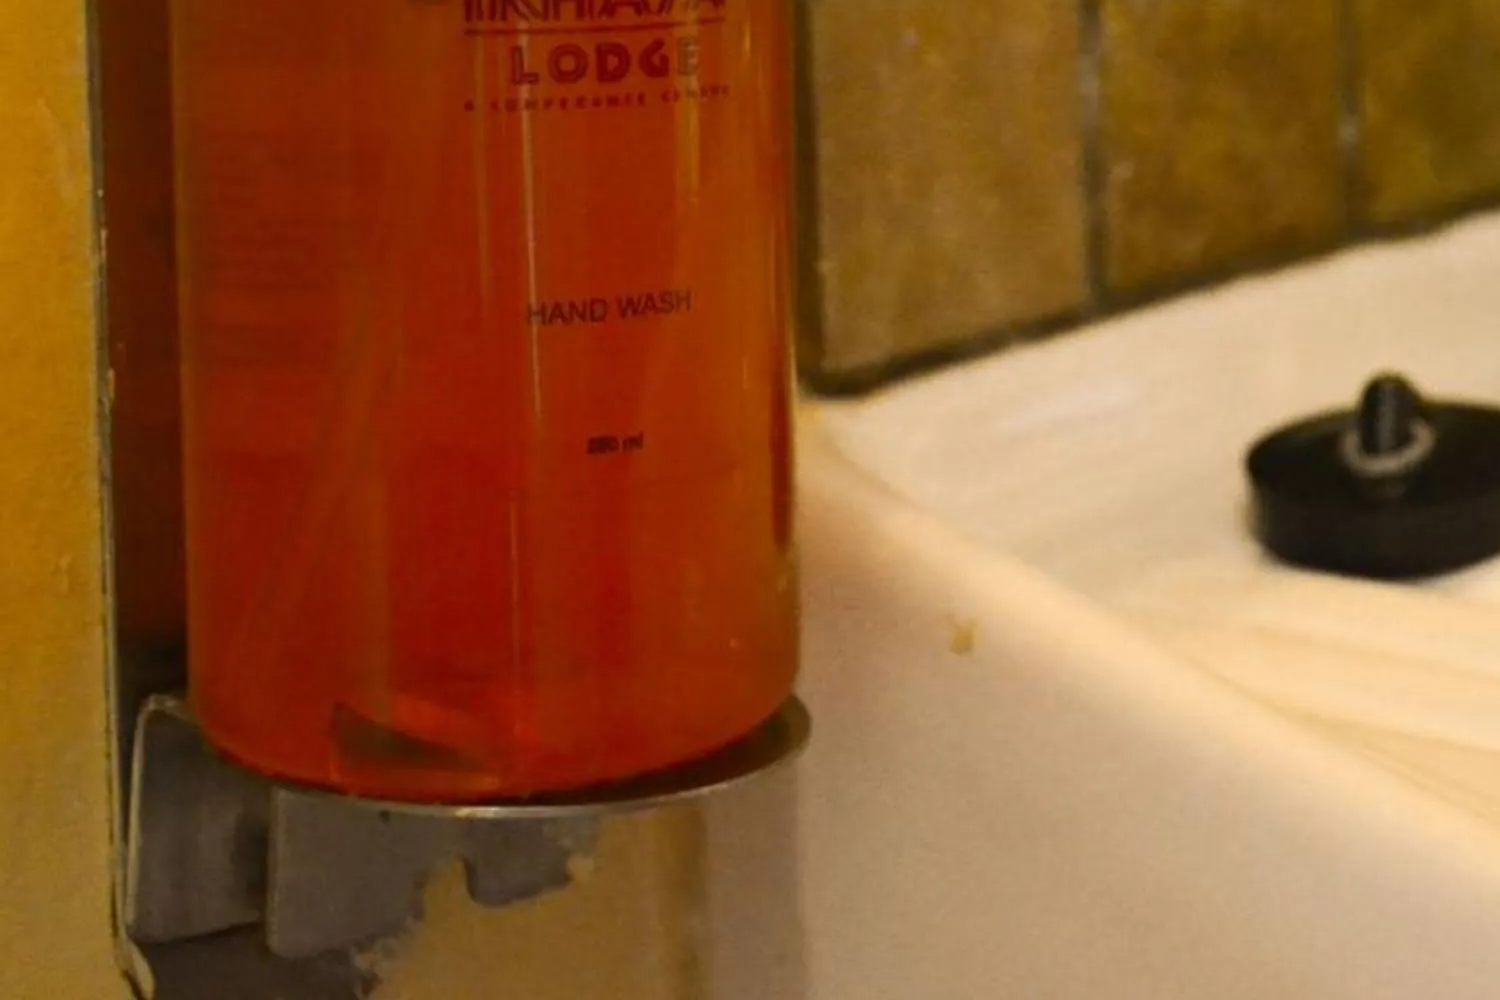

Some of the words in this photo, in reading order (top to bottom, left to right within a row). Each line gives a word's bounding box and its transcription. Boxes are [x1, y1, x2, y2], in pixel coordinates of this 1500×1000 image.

[509, 37, 698, 86] LODGE
[527, 297, 608, 326] HAND
[617, 288, 692, 319] WASH
